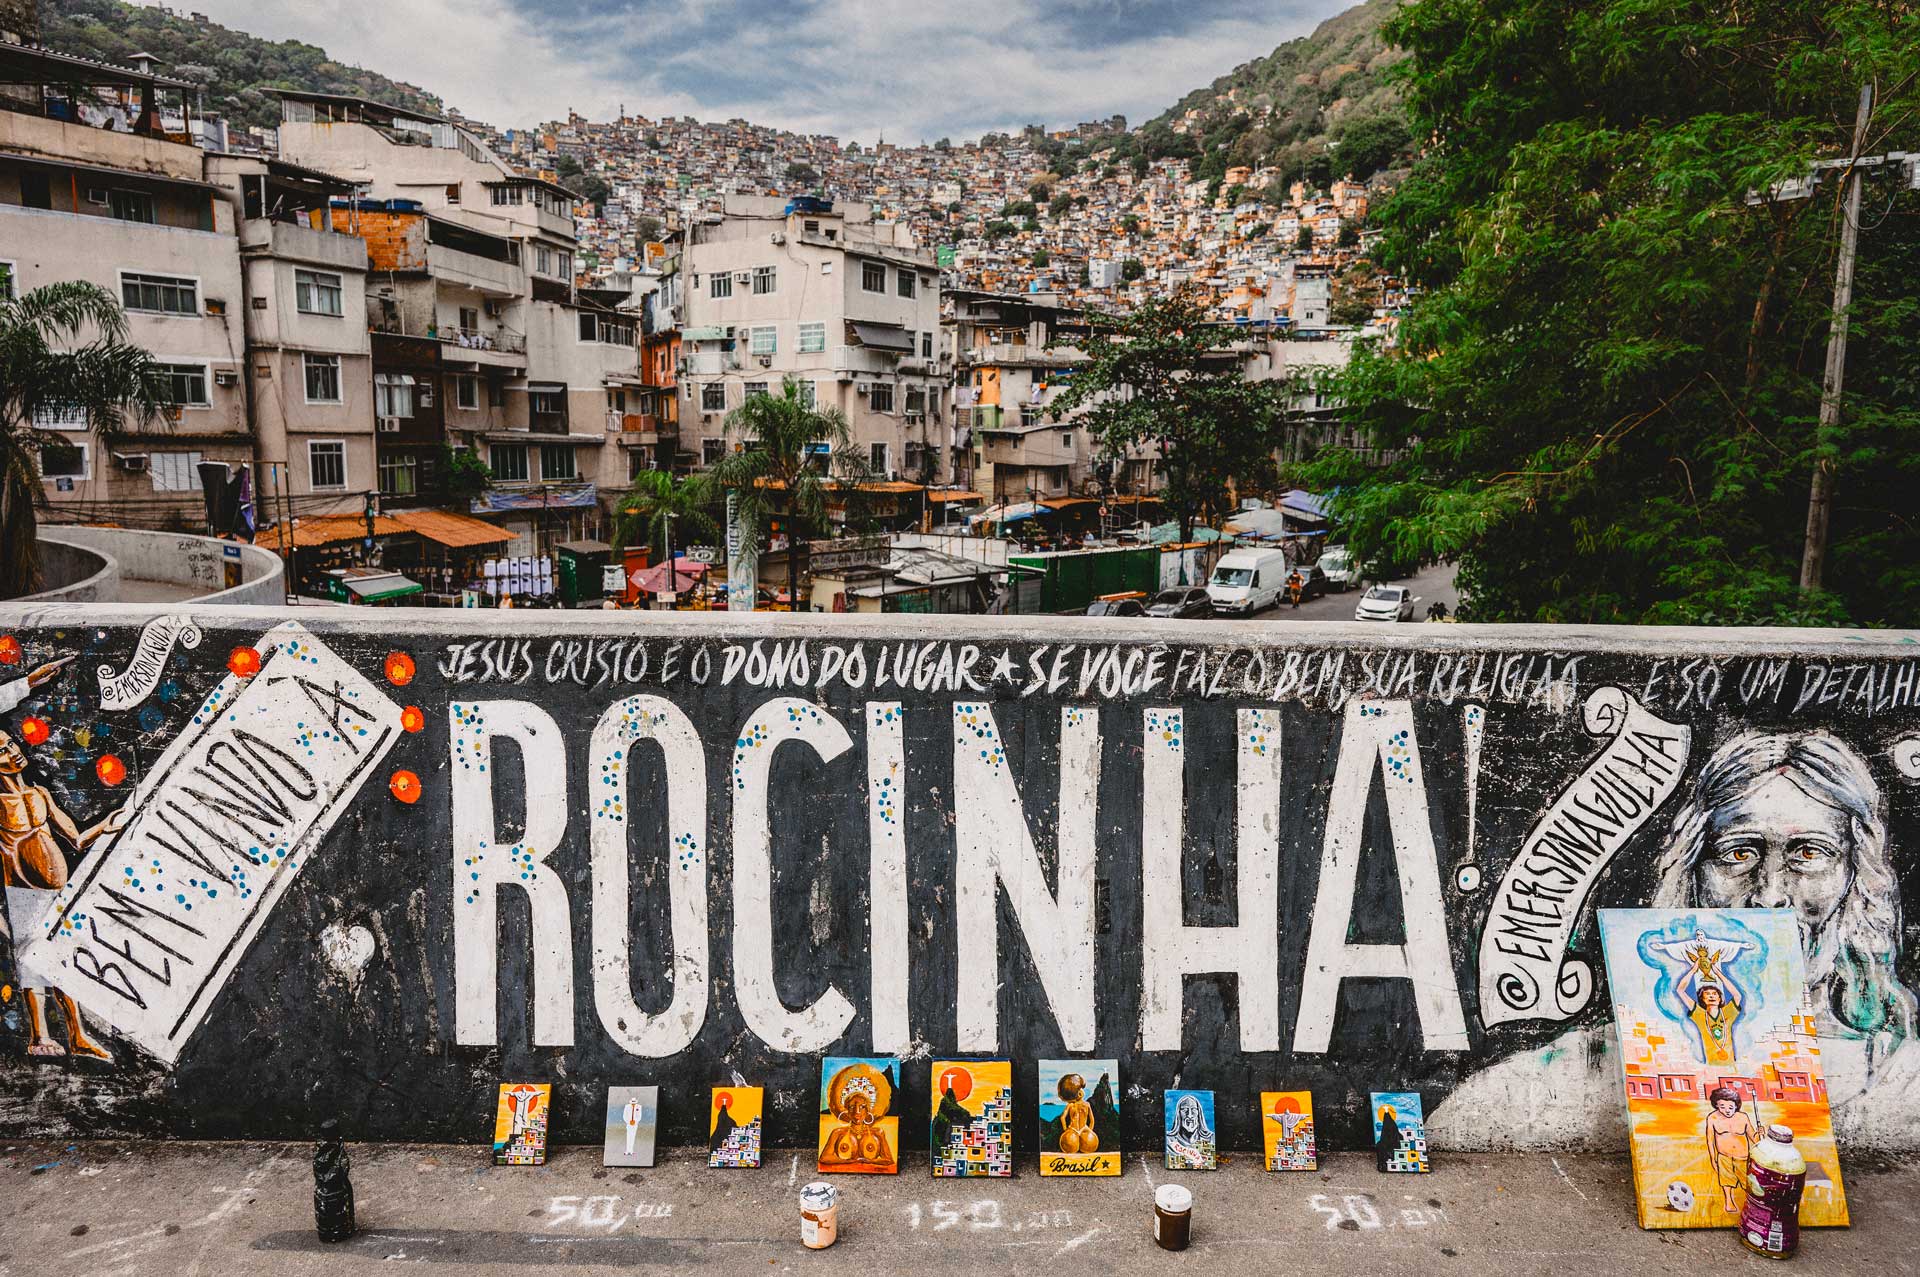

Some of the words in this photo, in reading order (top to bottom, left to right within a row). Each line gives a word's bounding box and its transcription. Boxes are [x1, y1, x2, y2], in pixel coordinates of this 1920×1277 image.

[438, 640, 533, 684] JESUS
[546, 639, 648, 692] CRISTO
[691, 643, 711, 684] O
[720, 637, 811, 690] DONO
[815, 640, 867, 688] DO
[875, 640, 988, 693] LUGAR
[1021, 644, 1075, 697] SE
[1244, 649, 1266, 694] O
[1358, 649, 1423, 697] SUA
[1739, 657, 1791, 705] UM
[73, 884, 207, 1009] BEM
[146, 728, 319, 883] VINDO
[1049, 1156, 1101, 1173] Brasil
